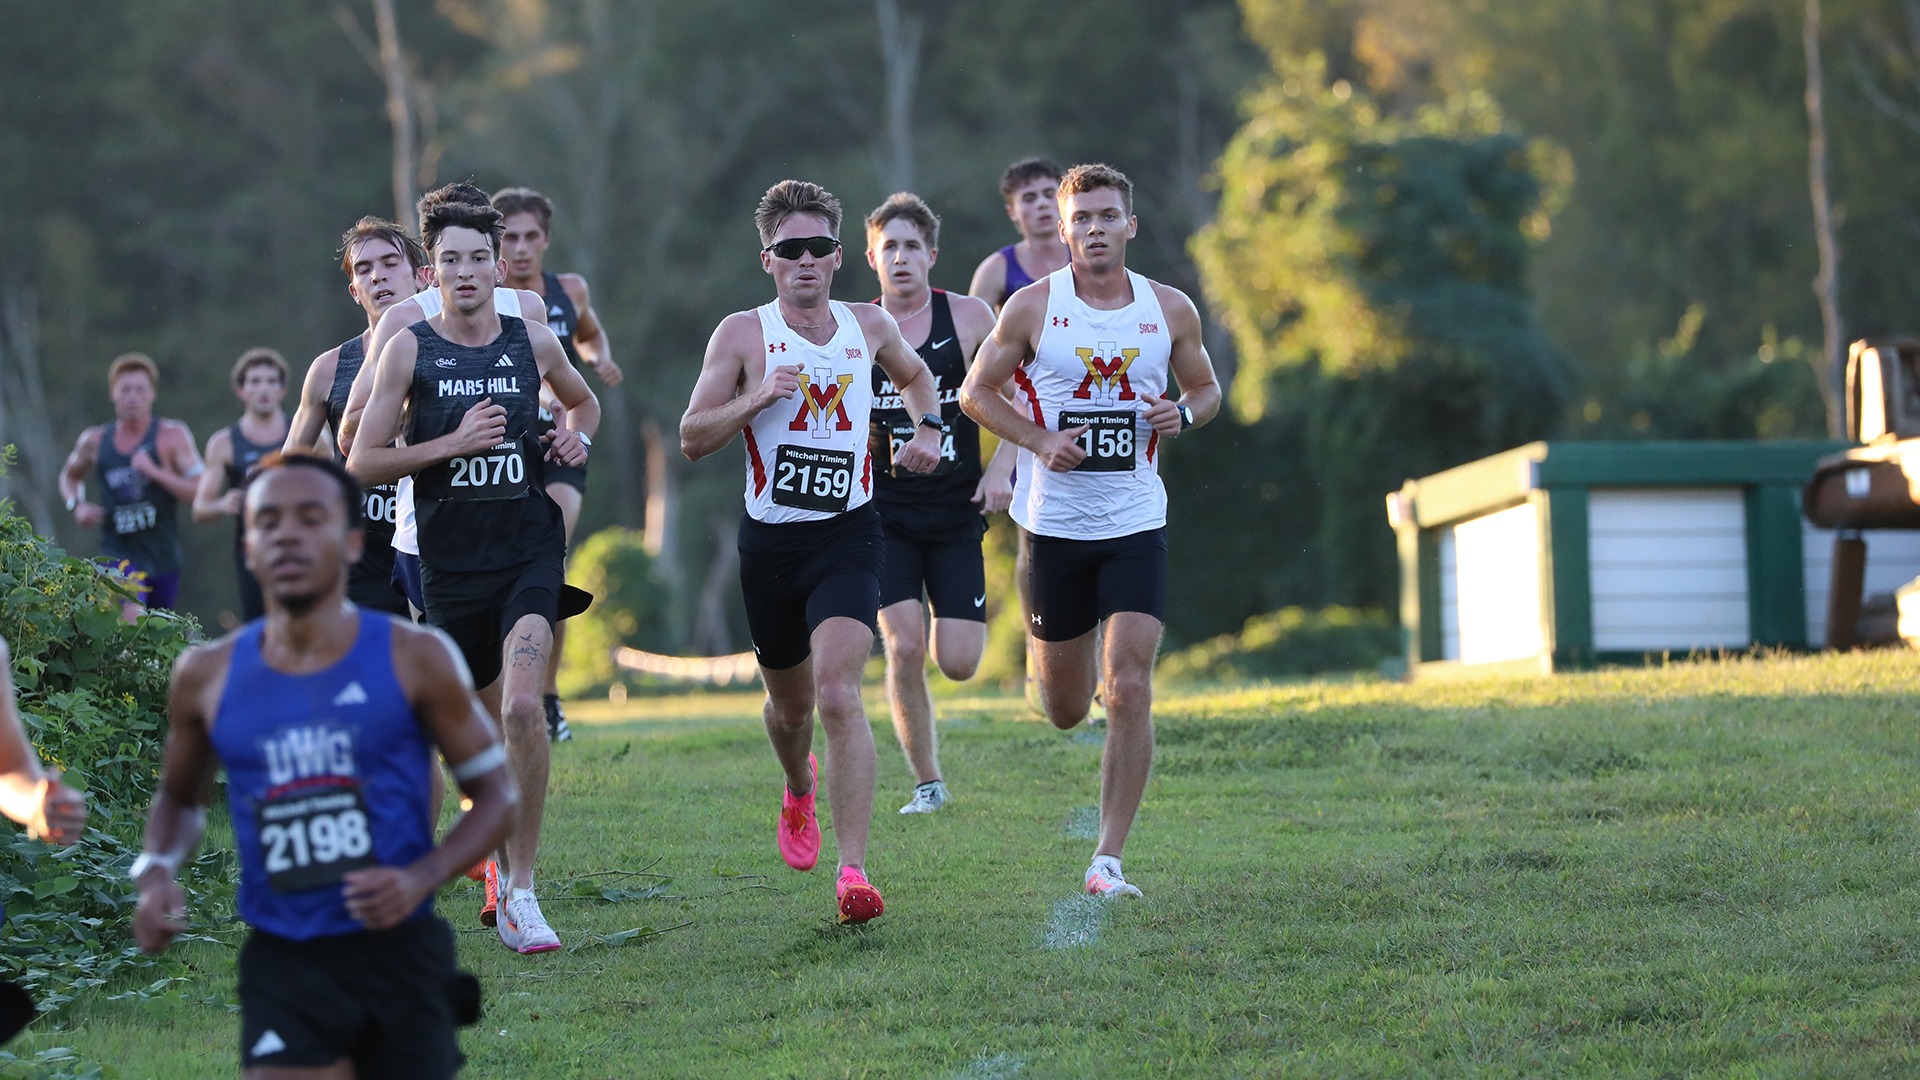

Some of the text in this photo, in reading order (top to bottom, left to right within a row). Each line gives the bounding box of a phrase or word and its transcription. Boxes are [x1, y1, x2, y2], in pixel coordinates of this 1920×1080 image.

[438, 377, 520, 397] MARS HILL
[1067, 416, 1130, 424] Mitchell Timing
[786, 449, 848, 465] Mitchell Timing
[1074, 429, 1133, 458] 158
[450, 453, 524, 487] 2070
[776, 461, 850, 499] 2159
[264, 727, 354, 785] UWG
[261, 809, 372, 873] 2198
